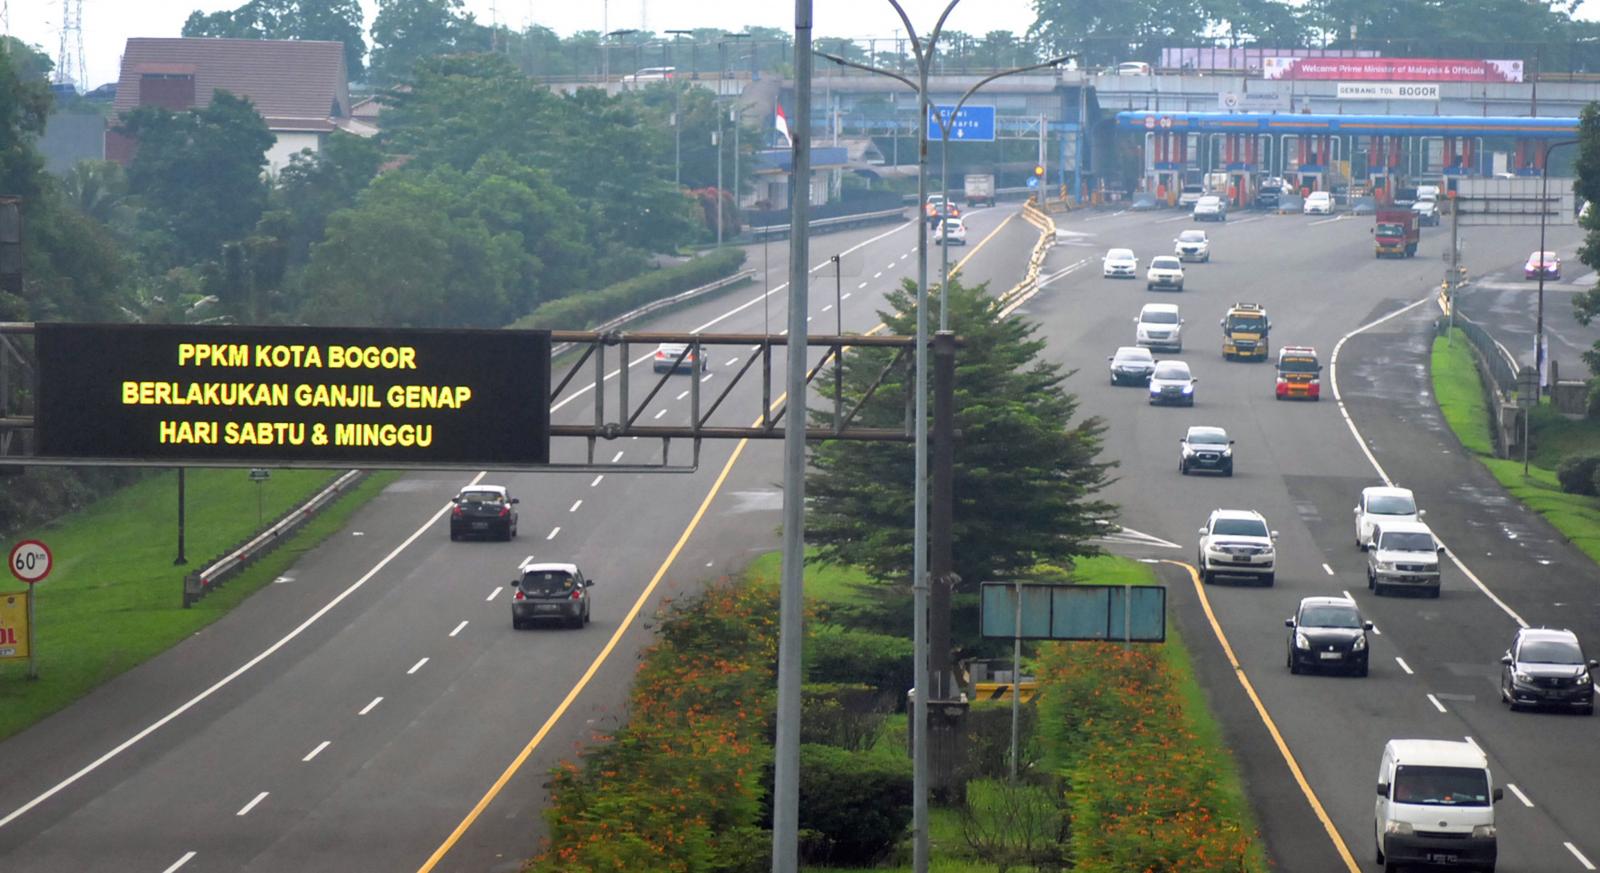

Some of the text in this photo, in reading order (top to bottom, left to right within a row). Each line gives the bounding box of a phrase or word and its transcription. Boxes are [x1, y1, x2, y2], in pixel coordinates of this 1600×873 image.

[1301, 64, 1485, 75] Welcome Prime Minister of Malaysia & Officials
[1399, 86, 1437, 96] BOGOR
[178, 344, 417, 370] PPKM KOTA BOGOR
[122, 381, 472, 409] BERLAKUKAN GANJIL GENAP
[160, 420, 433, 448] HARI SABTU & MINGGU
